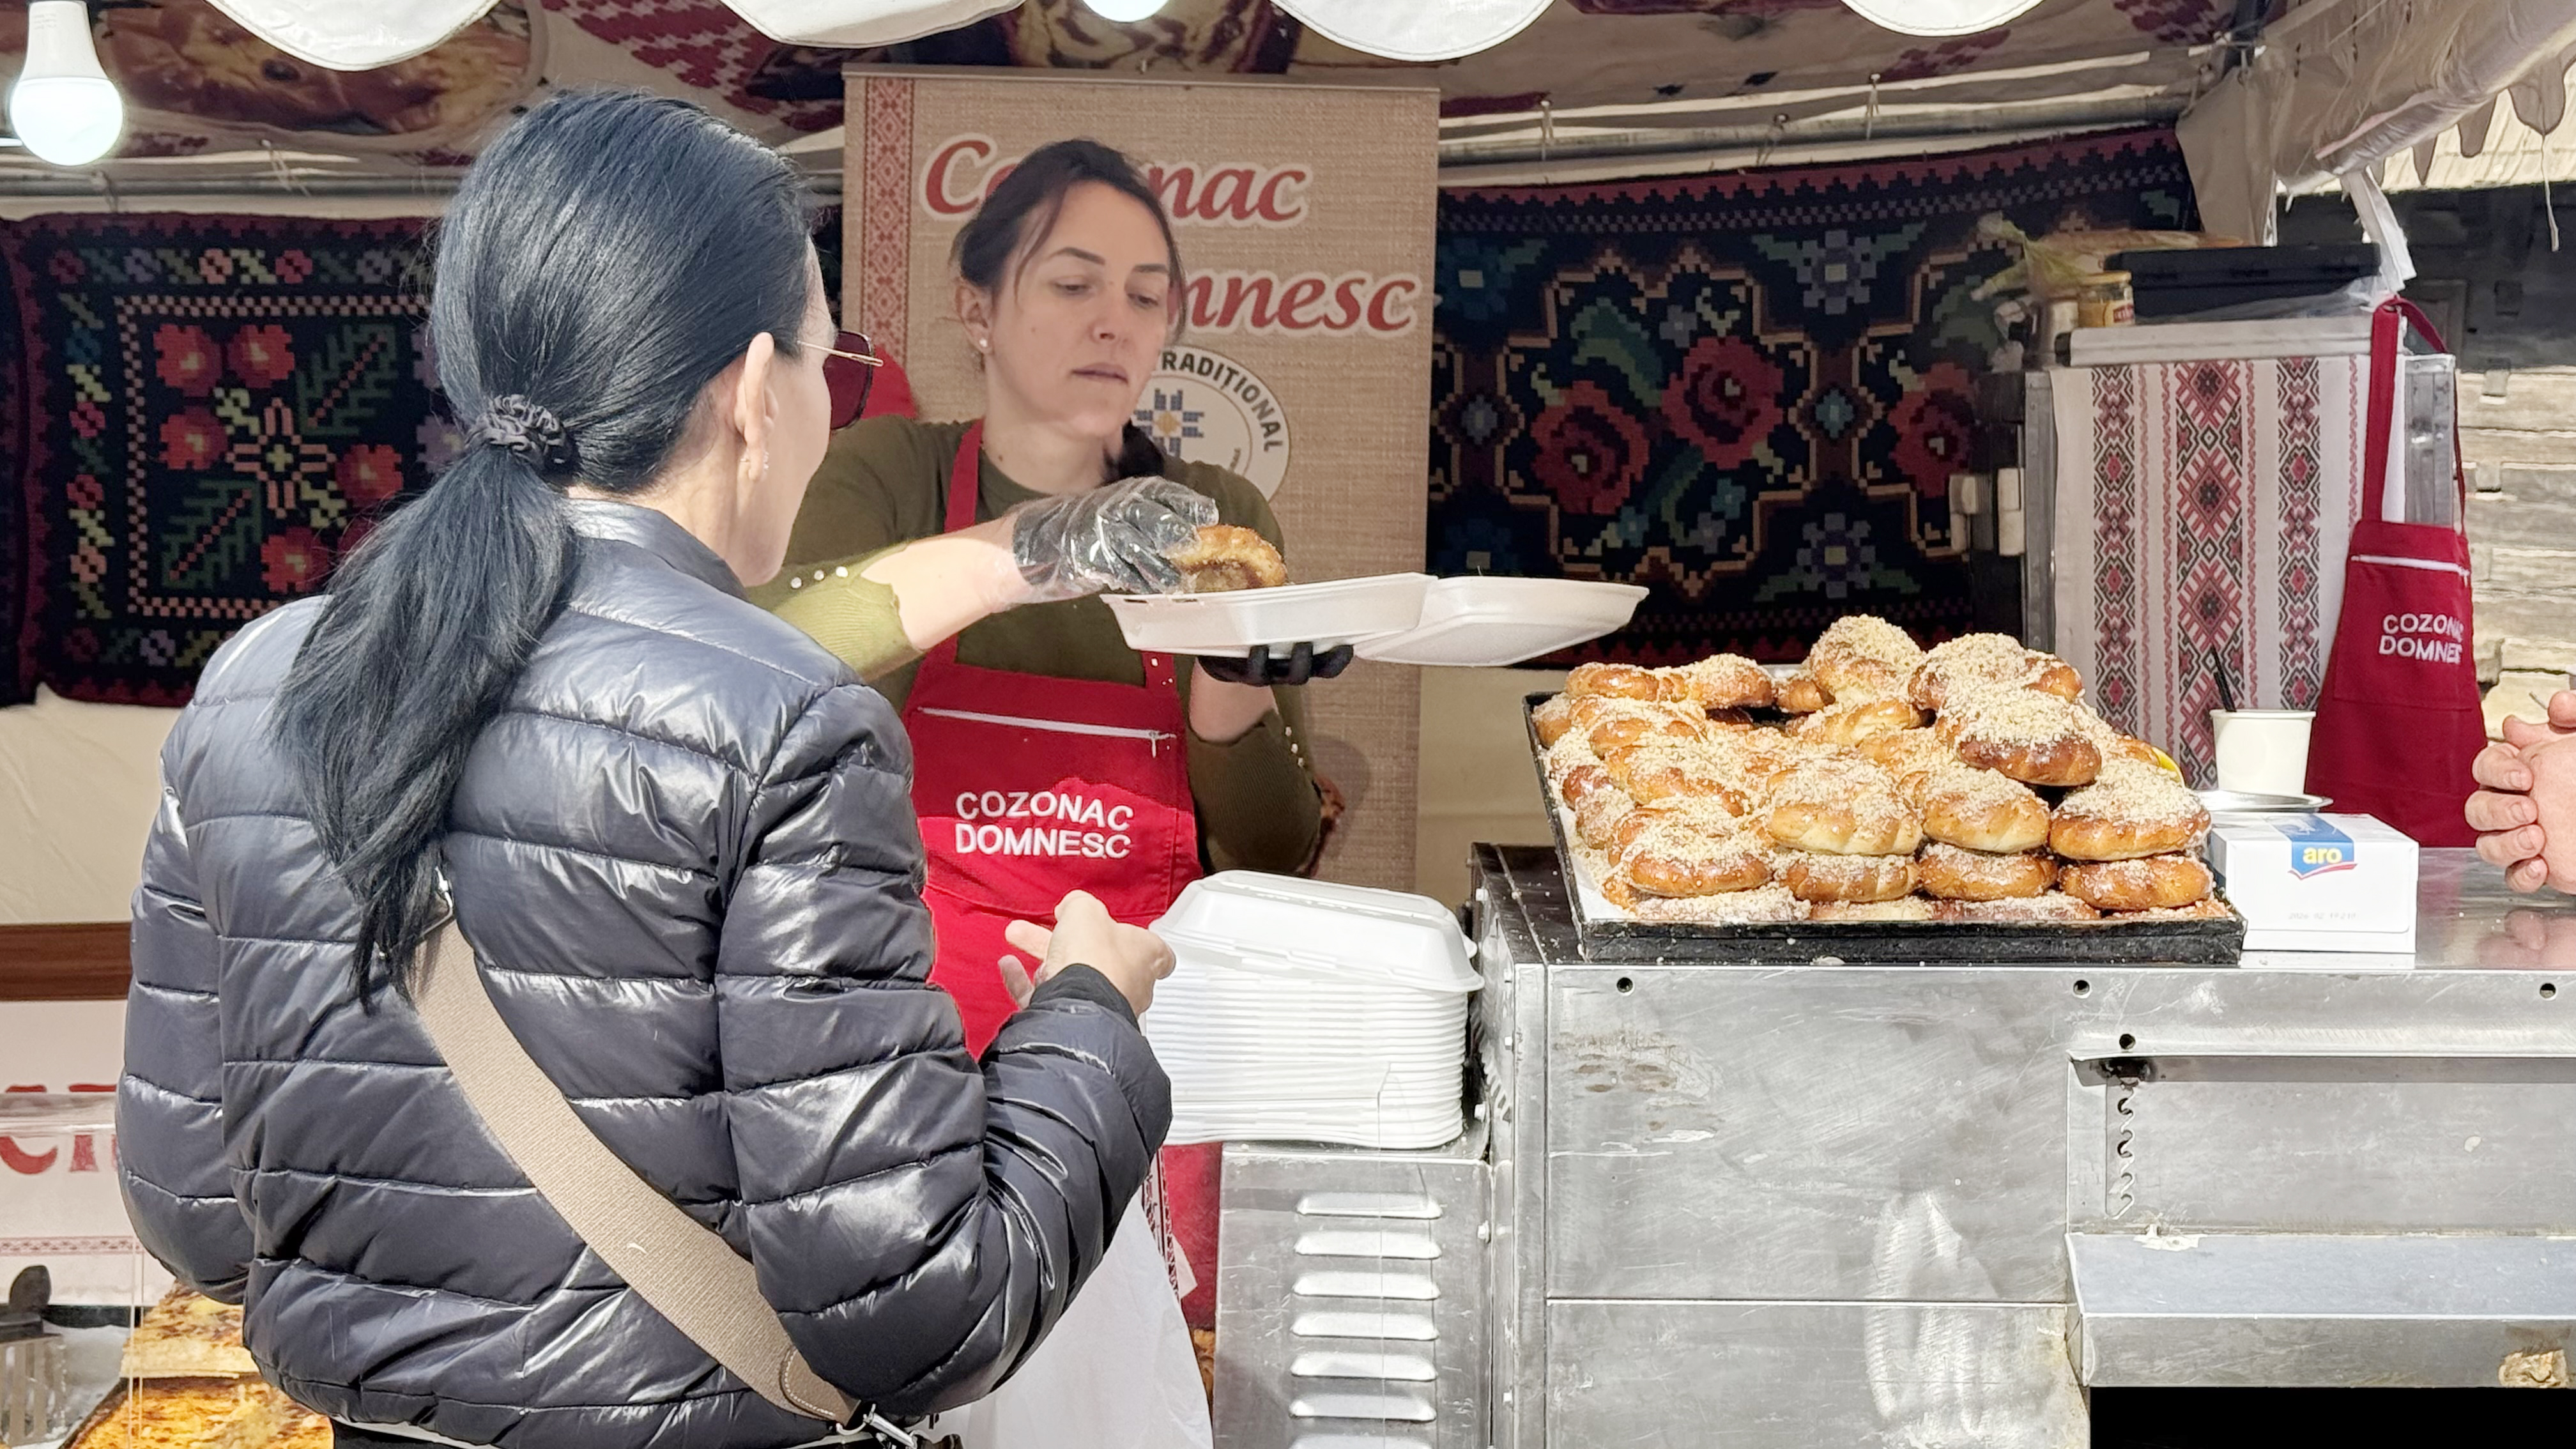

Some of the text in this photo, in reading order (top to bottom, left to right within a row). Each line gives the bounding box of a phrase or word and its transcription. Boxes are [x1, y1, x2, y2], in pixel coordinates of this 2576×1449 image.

[926, 139, 1307, 222] Cnac
[1160, 351, 1284, 452] RADIȚIONAL
[955, 790, 1134, 832] COZONAC
[955, 823, 1131, 859] DOMNESC
[2302, 847, 2343, 865] aro
